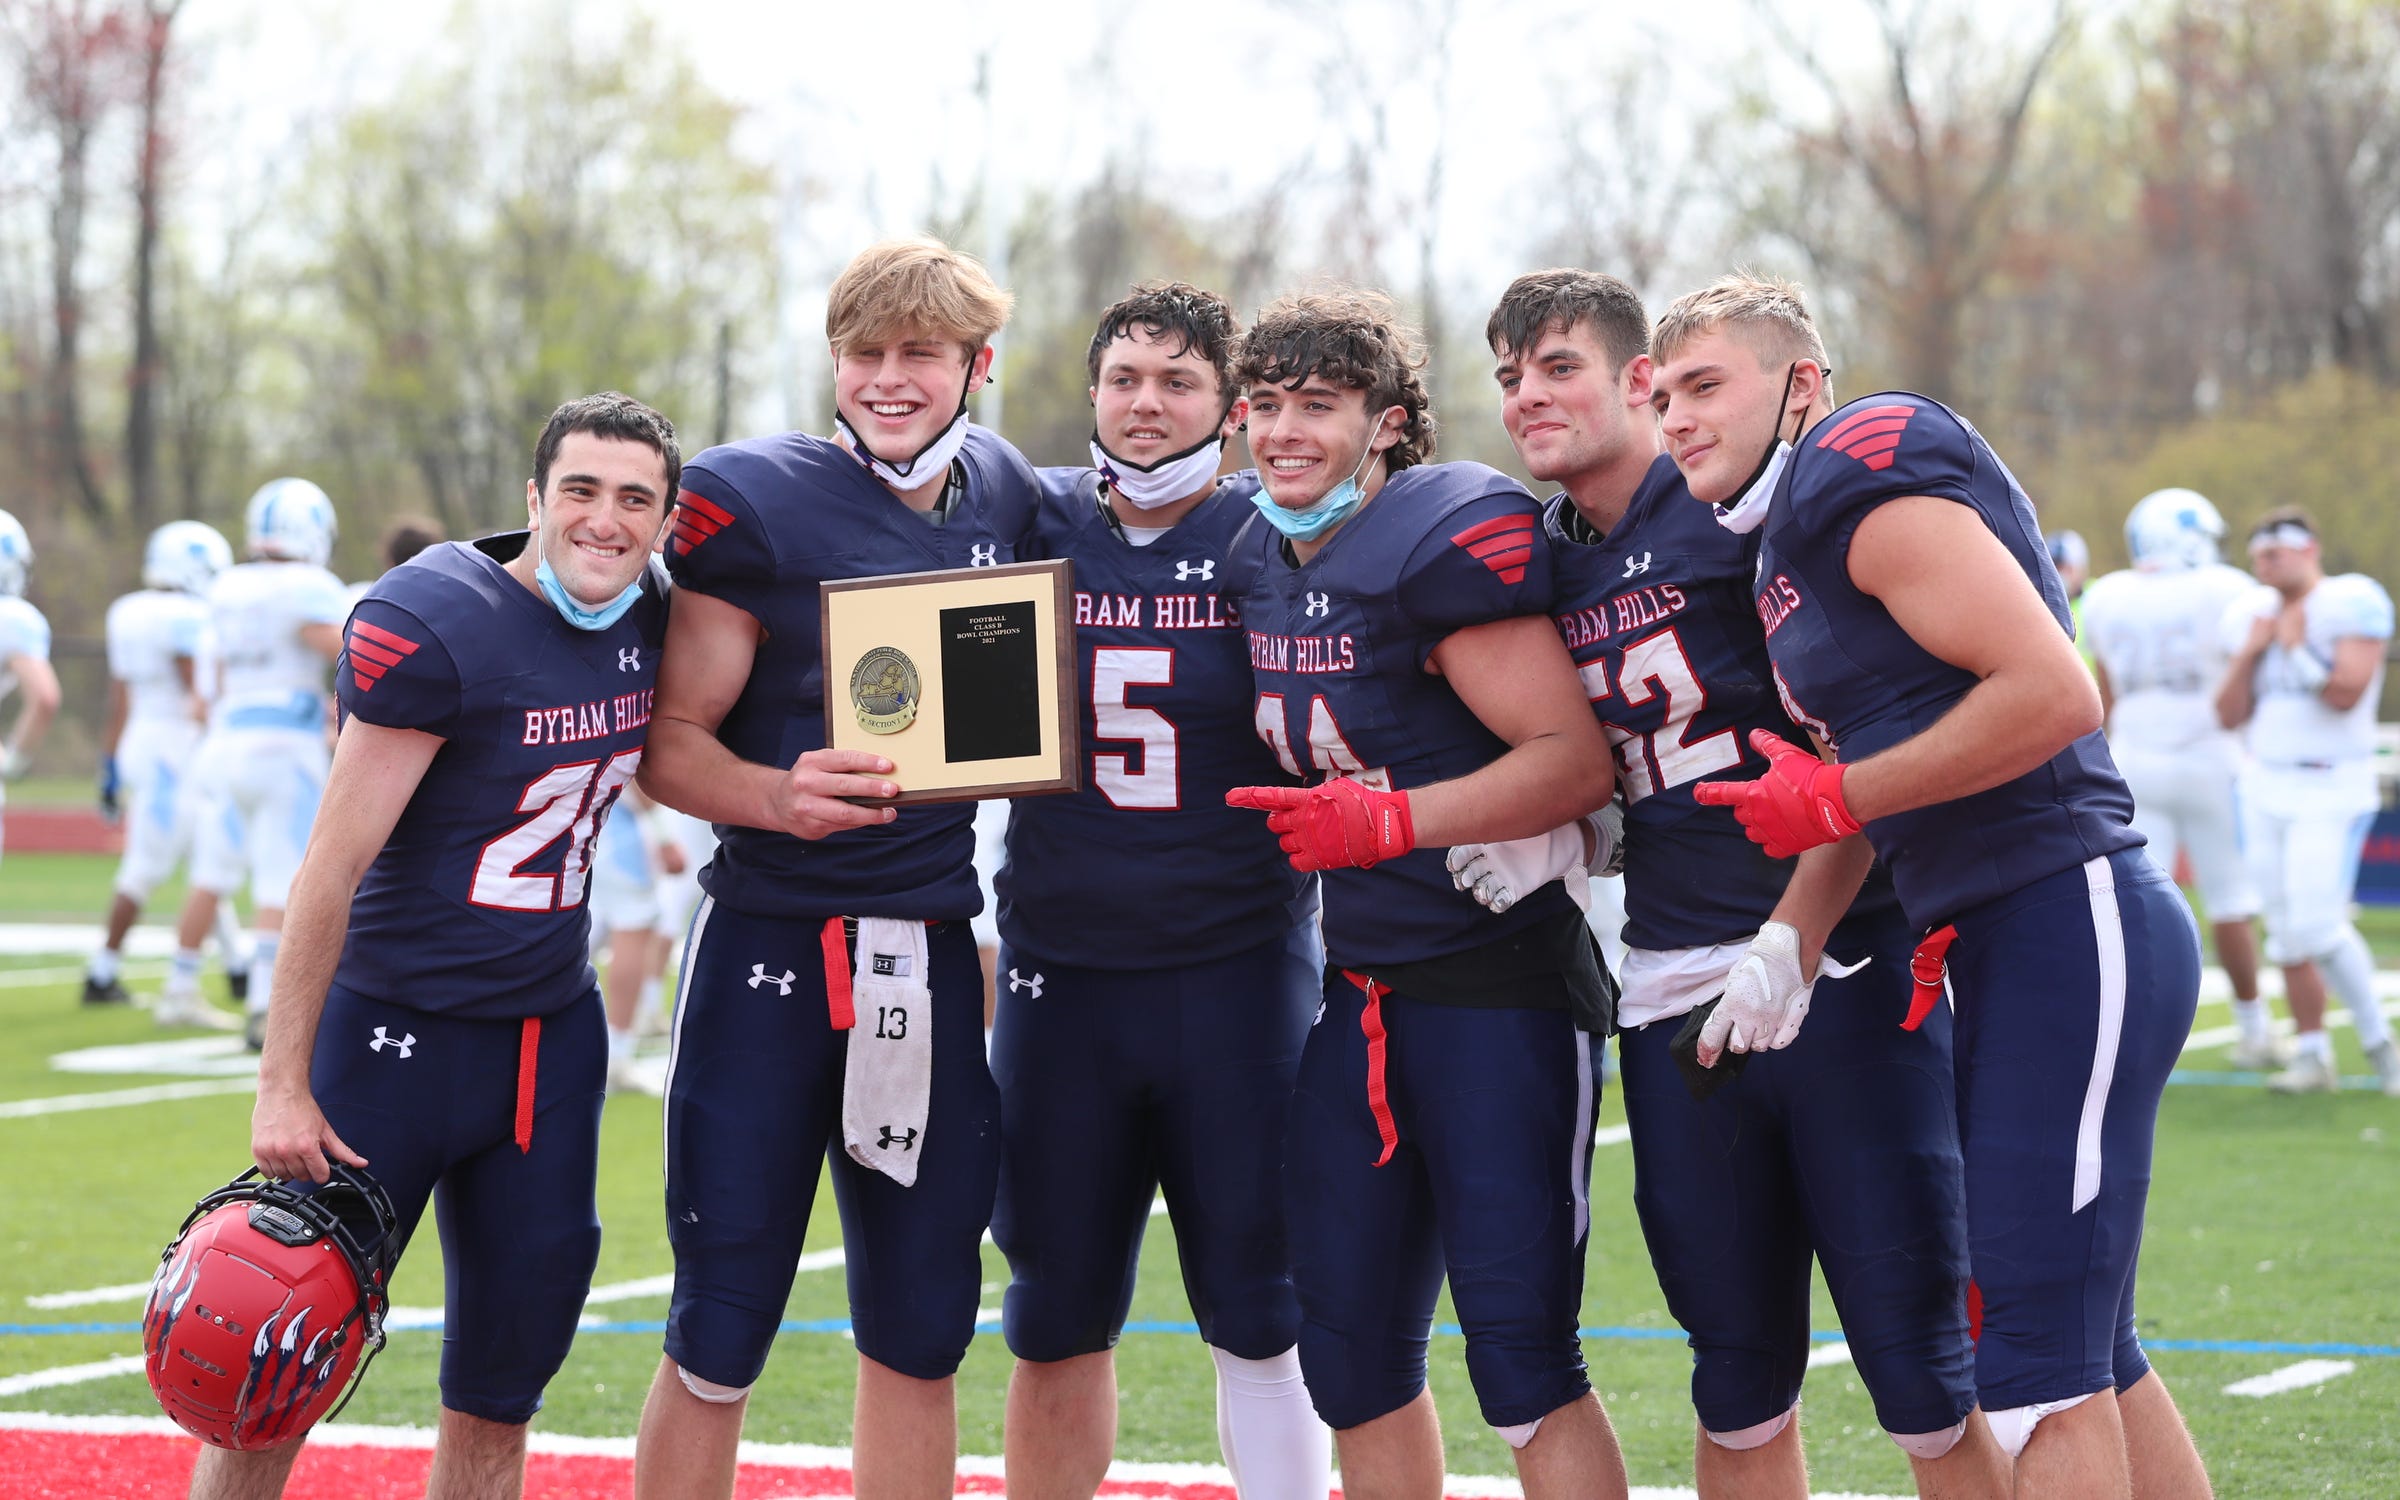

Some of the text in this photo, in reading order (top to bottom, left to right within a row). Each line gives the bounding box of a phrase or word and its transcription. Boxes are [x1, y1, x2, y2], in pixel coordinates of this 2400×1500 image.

[969, 615, 1006, 624] FOOTBALL
[1075, 592, 1141, 627] RAM
[1556, 583, 1687, 650] RAM HILLS
[956, 628, 1020, 640] BOWL CHAMPIONS
[1249, 630, 1354, 673] BYRAM HILLS
[522, 700, 609, 745] BYRAM
[868, 719, 896, 728] SECTION
[1091, 645, 1182, 810] 5
[875, 1006, 908, 1040] 13
